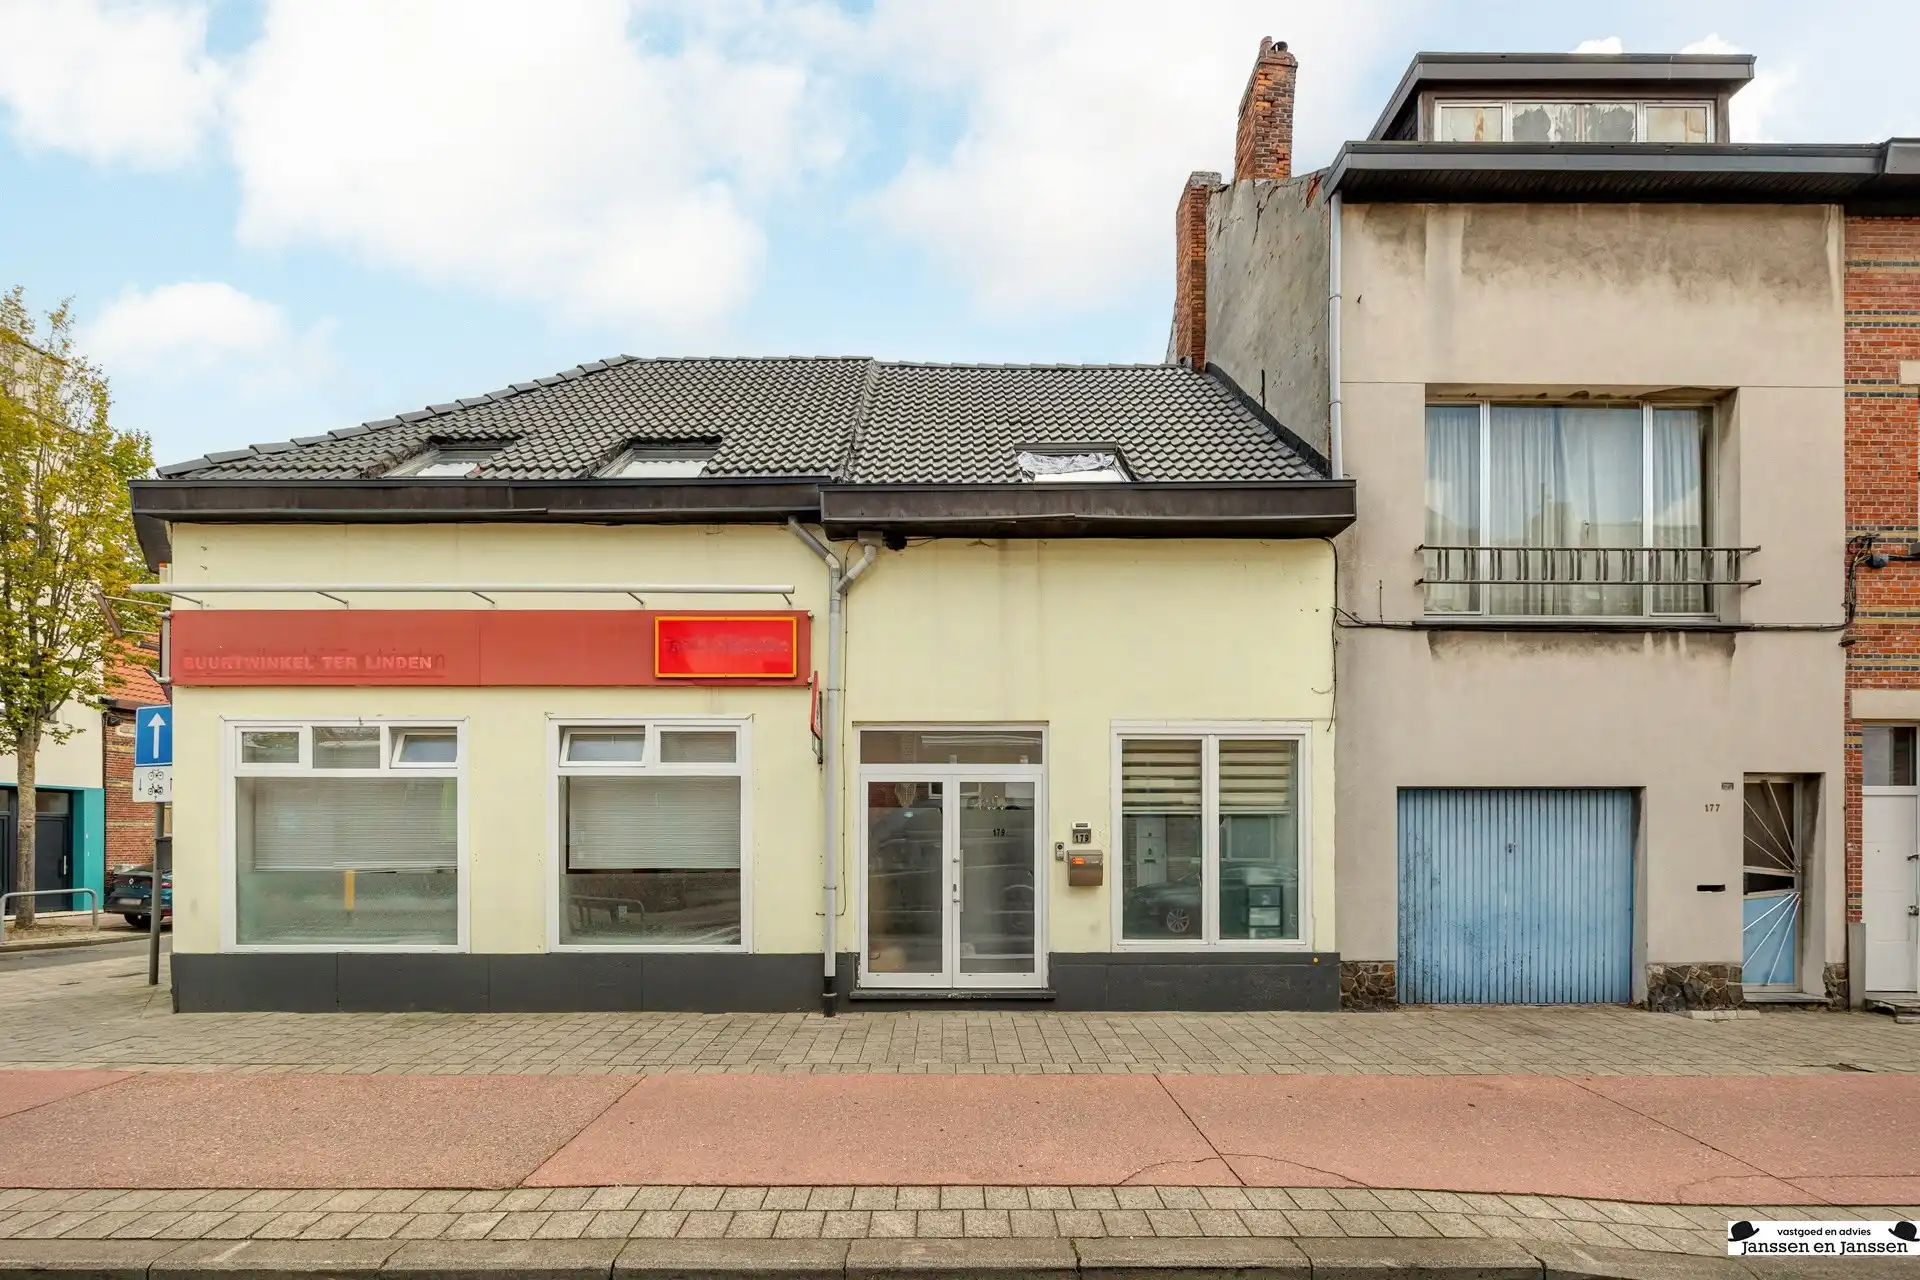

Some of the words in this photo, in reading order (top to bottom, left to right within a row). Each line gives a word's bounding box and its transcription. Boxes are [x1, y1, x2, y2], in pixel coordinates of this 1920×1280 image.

[183, 656, 314, 670] BUURTWINKEL
[322, 656, 357, 670] TER
[365, 656, 432, 670] LINDEN
[1705, 804, 1720, 812] 177
[992, 828, 1006, 837] 179
[1075, 834, 1089, 843] 179
